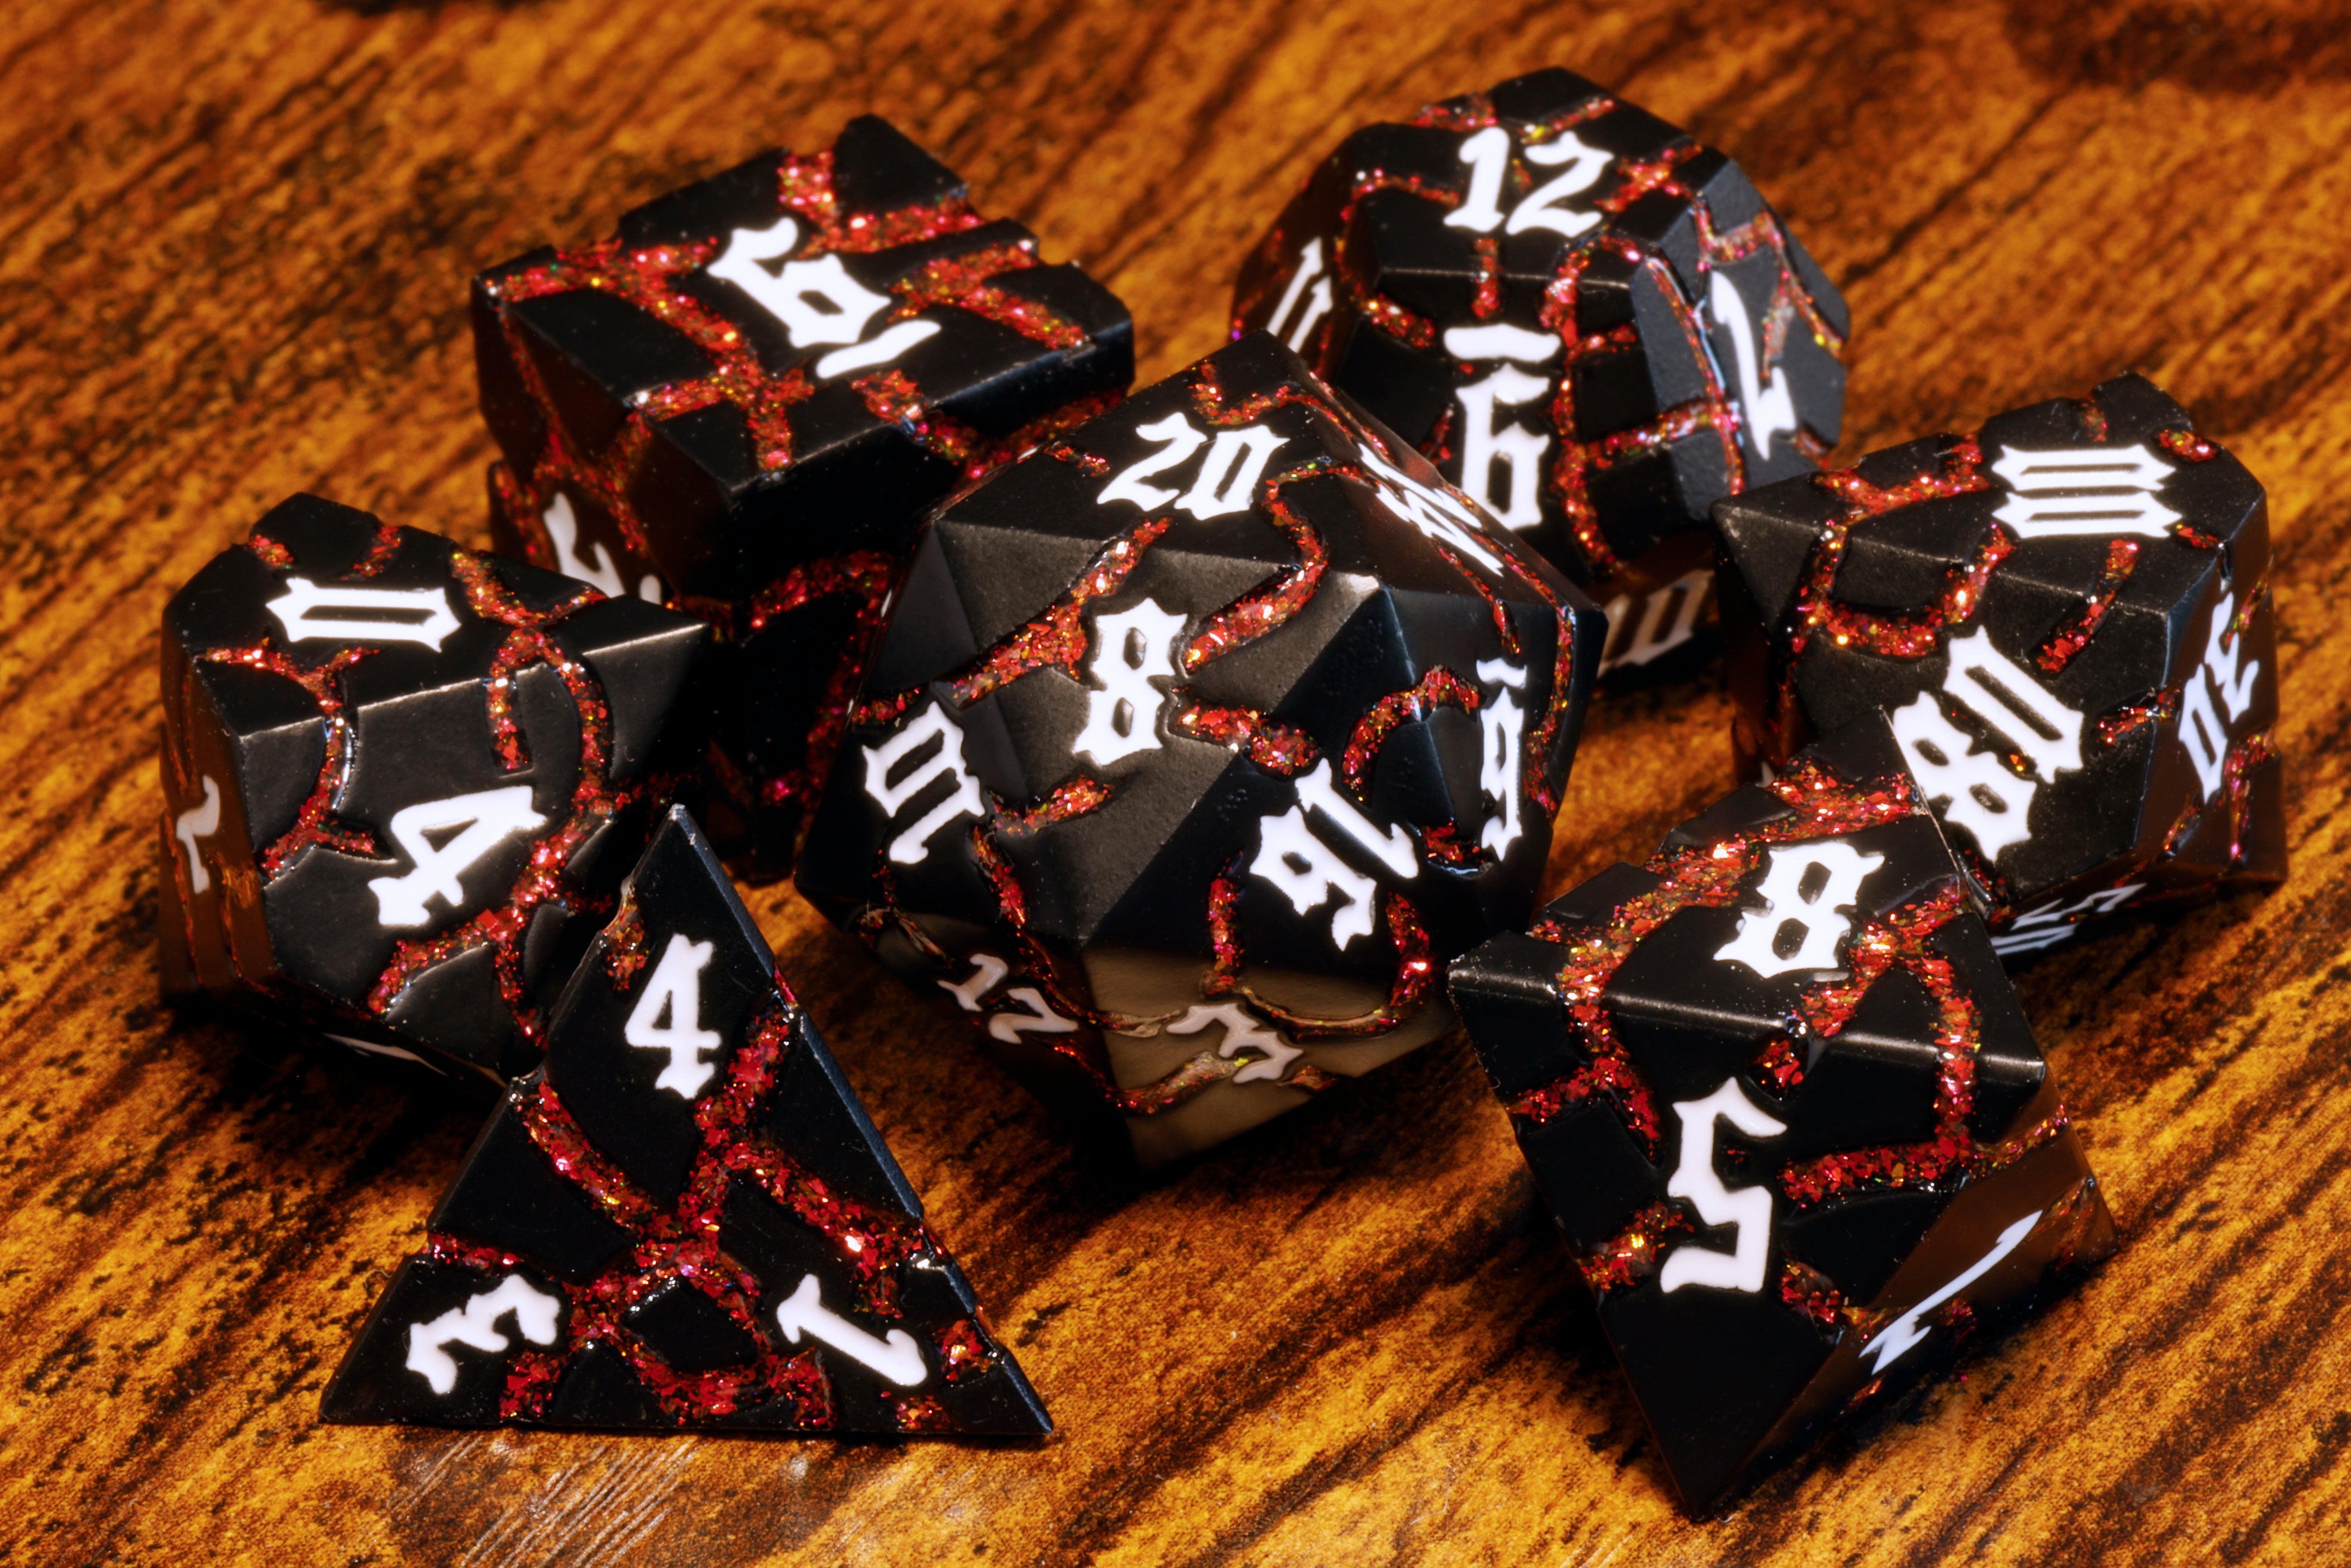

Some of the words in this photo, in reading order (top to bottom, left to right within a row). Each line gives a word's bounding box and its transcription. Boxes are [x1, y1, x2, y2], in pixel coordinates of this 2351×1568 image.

[1442, 125, 1615, 239] 12
[1096, 411, 1291, 522] 20
[1990, 442, 2183, 540] 00
[264, 576, 462, 654] 0
[1070, 597, 1189, 768] 8
[861, 700, 986, 865] 10
[1887, 624, 2085, 863] 80
[366, 784, 548, 928] 4
[1248, 757, 1419, 952] 16
[1712, 839, 1886, 980] 8
[624, 933, 722, 1100] 4
[936, 953, 1079, 1045] 12
[1166, 1002, 1304, 1085] 3
[405, 1274, 561, 1395] 3
[776, 1273, 928, 1387] 1
